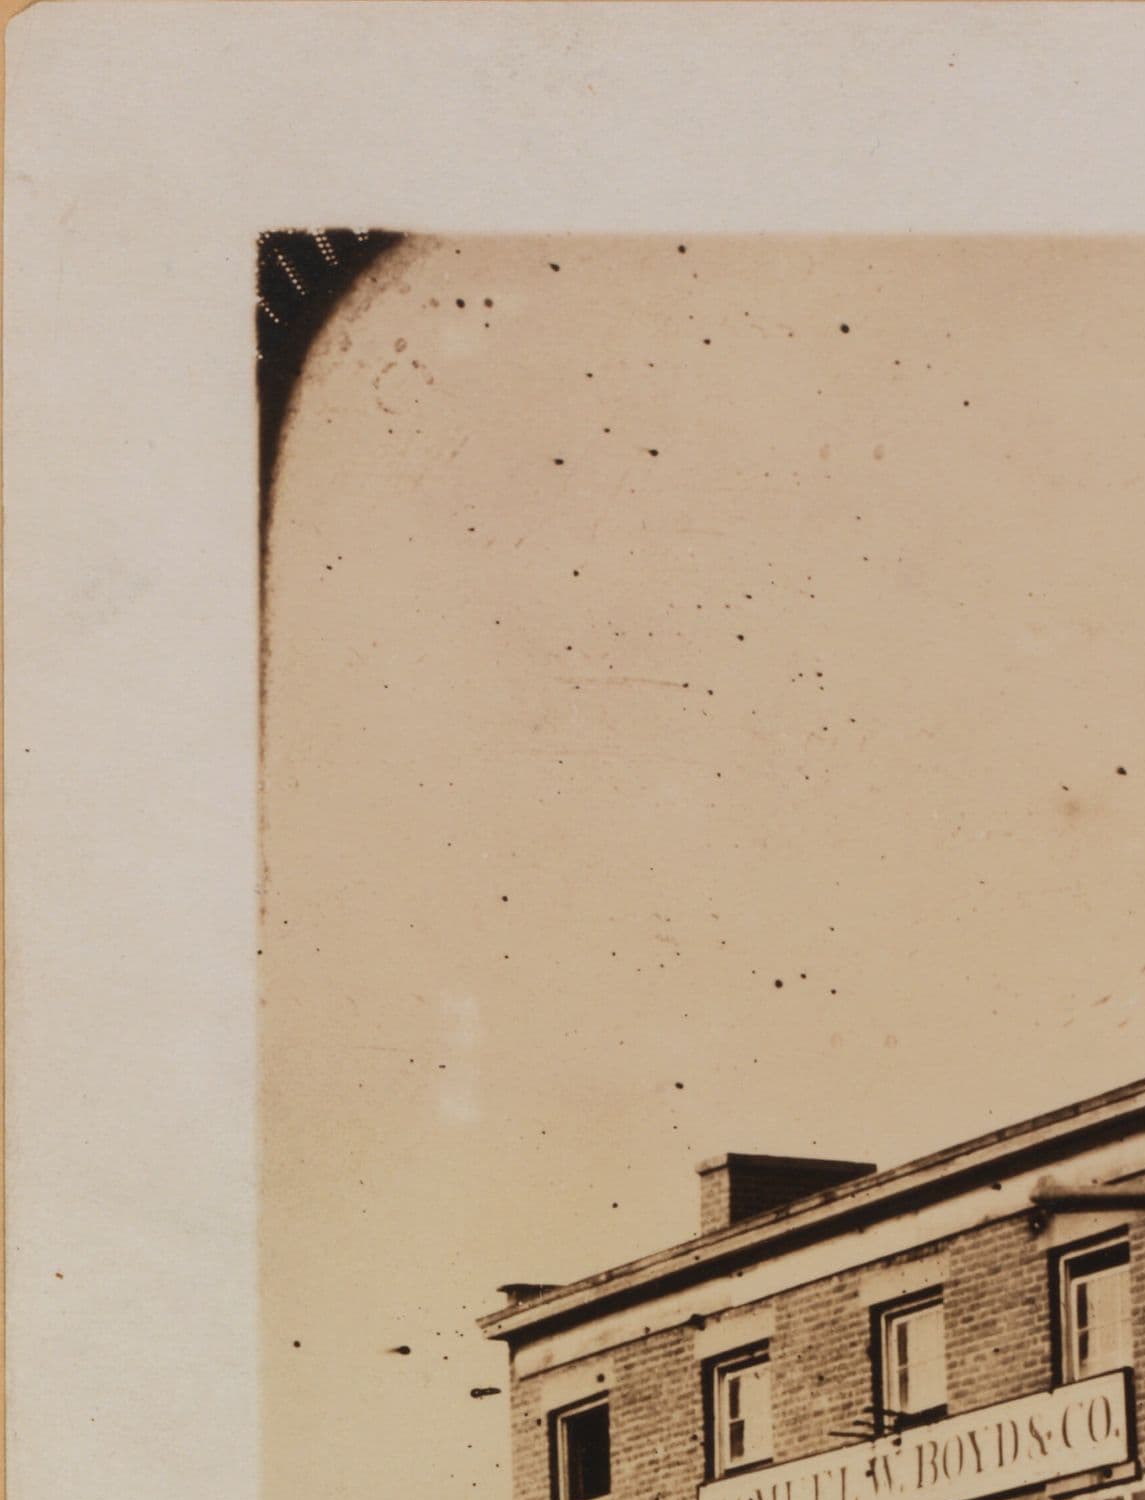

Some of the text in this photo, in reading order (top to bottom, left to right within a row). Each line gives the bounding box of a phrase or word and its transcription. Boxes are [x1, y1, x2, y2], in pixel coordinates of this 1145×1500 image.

[915, 1419, 1019, 1490] BOYD
[1028, 1415, 1053, 1461] &
[1061, 1394, 1121, 1450] CO.
